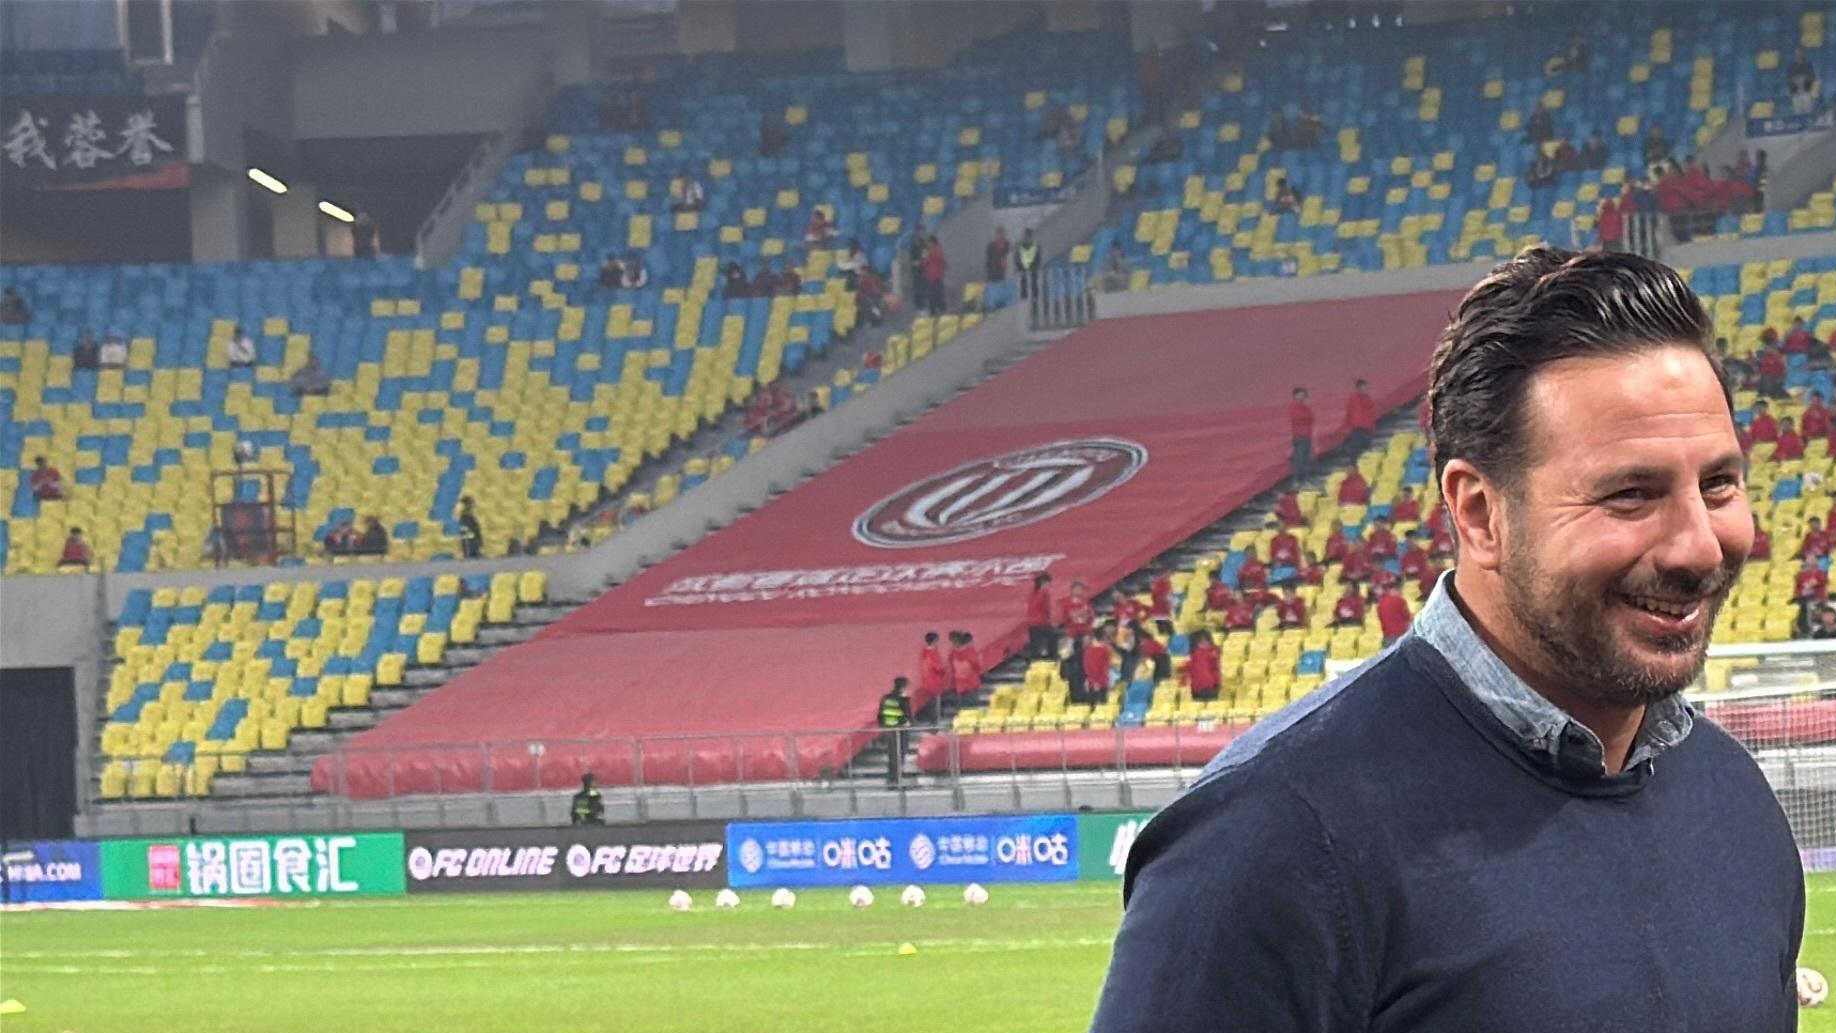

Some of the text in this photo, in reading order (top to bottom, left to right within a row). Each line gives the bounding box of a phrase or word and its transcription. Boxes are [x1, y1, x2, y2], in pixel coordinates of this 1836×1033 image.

[185, 837, 359, 894] 锅圈食汇
[433, 846, 558, 877] FC ONLINE
[590, 844, 627, 874] FC
